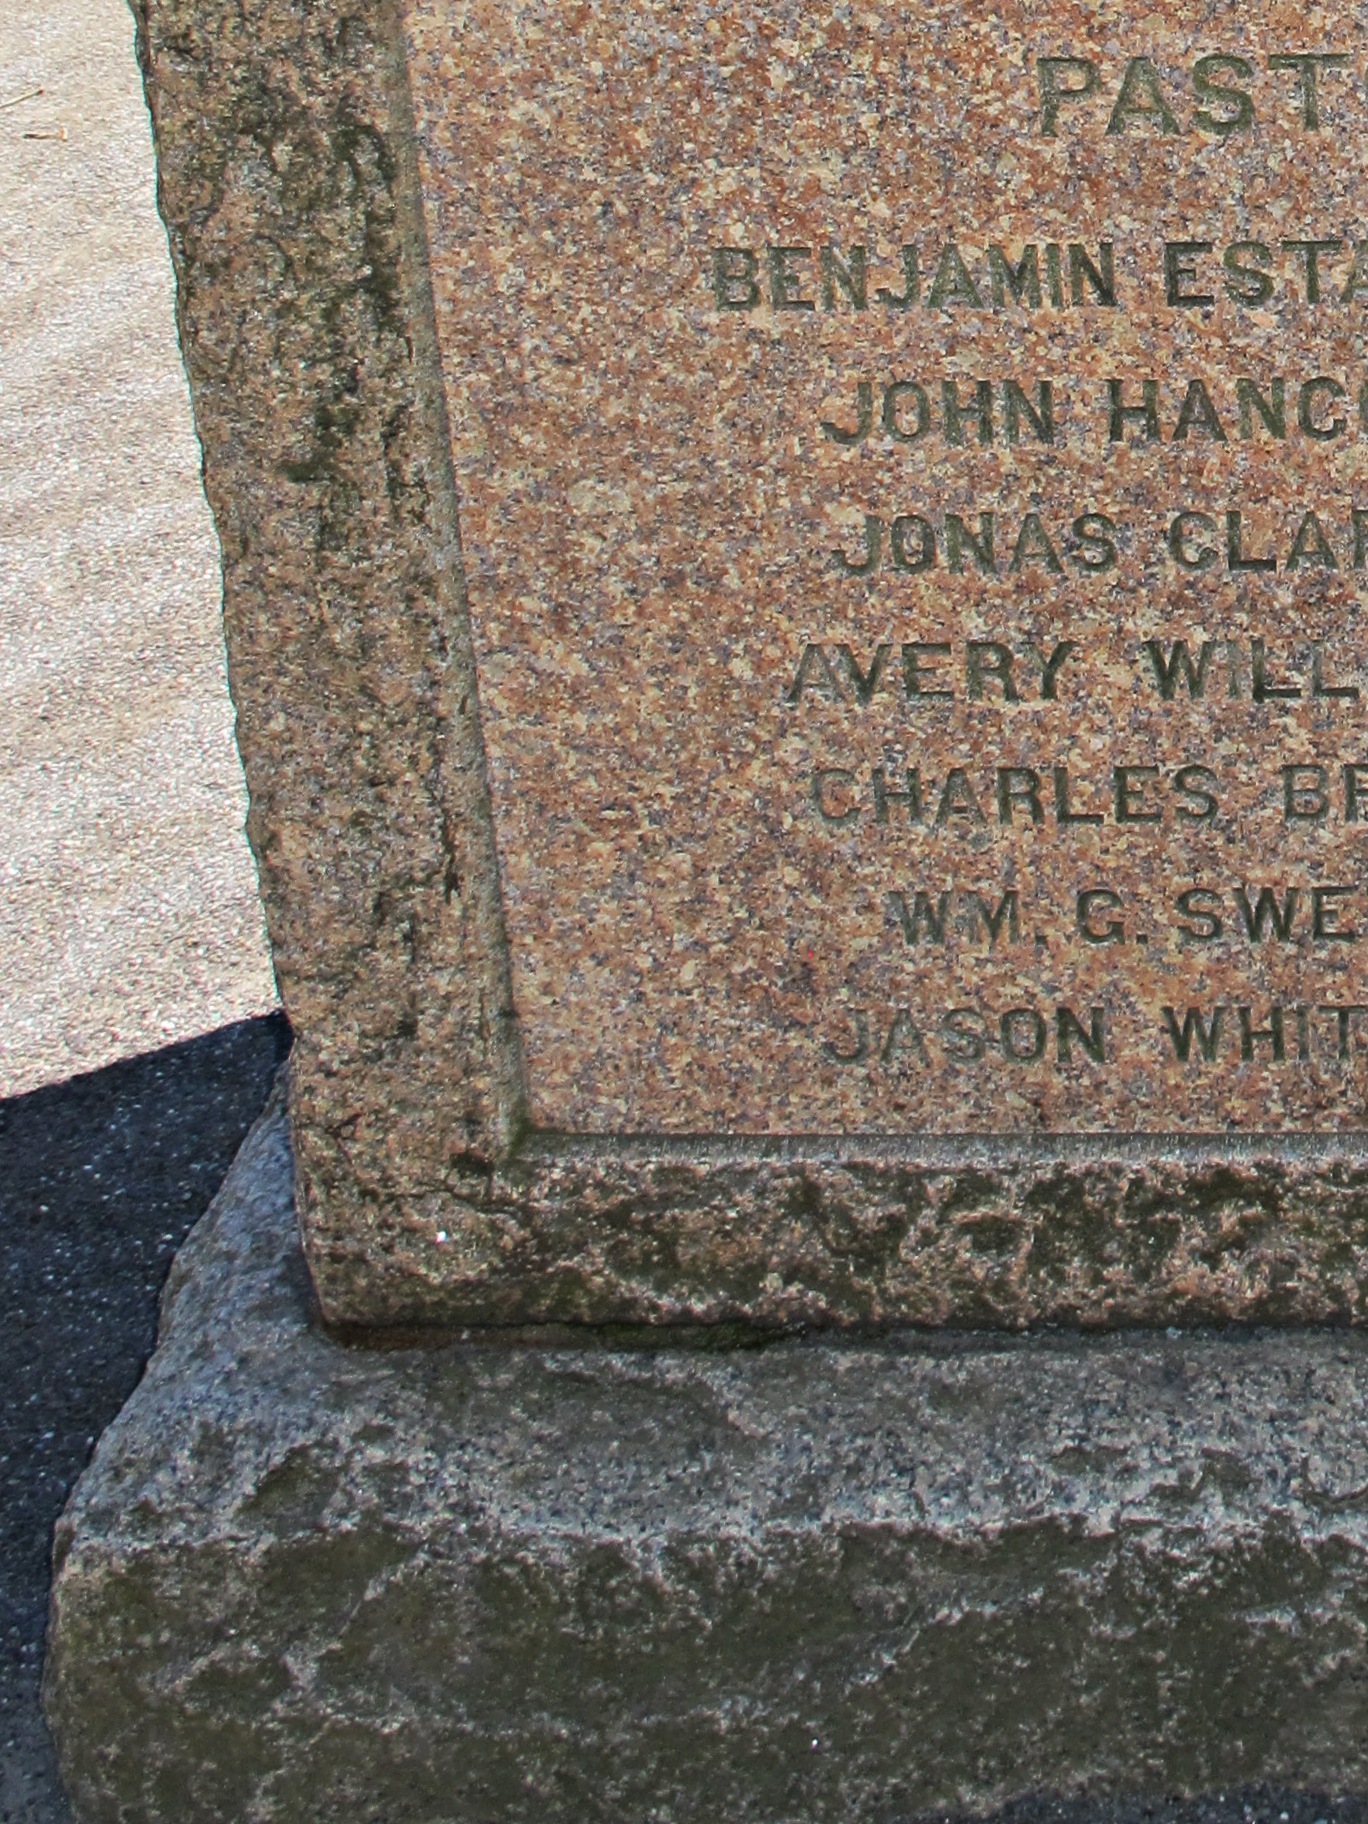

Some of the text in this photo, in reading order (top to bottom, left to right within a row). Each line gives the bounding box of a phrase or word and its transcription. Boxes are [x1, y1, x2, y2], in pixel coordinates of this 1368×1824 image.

[711, 242, 1117, 312] BENJAMIN
[819, 377, 1055, 447] JOHN
[833, 510, 1117, 575] JONAS
[787, 640, 1075, 704] AVERY
[815, 764, 1222, 825] CHARLES
[823, 1006, 1106, 1063] JASON
